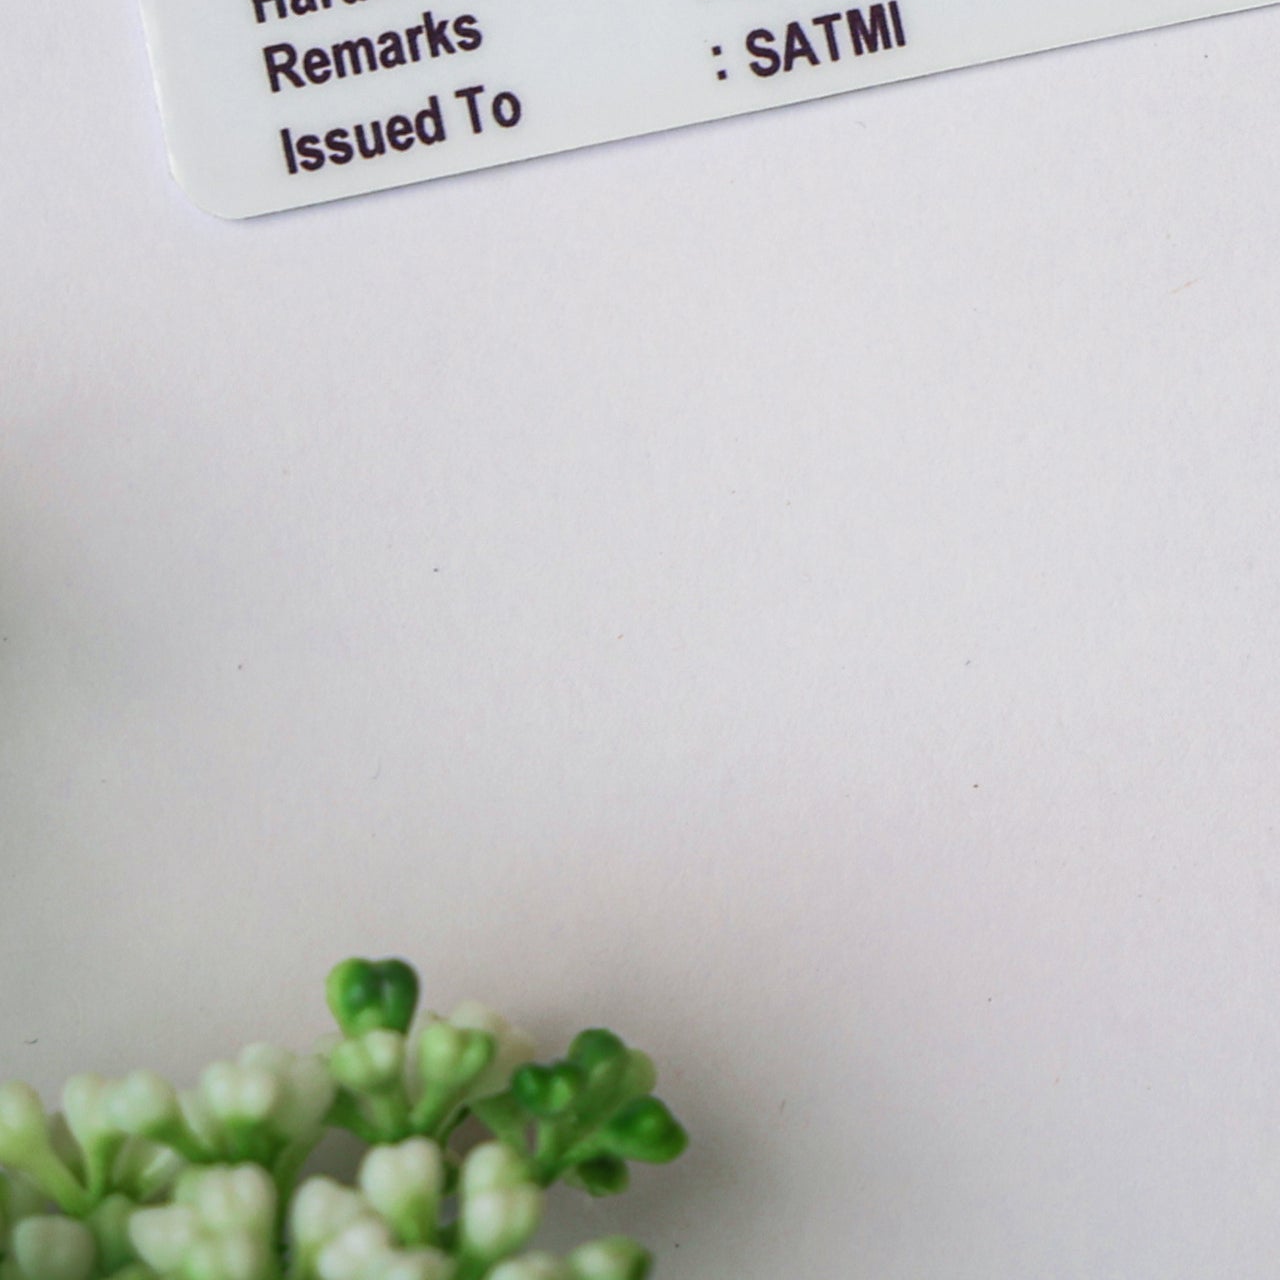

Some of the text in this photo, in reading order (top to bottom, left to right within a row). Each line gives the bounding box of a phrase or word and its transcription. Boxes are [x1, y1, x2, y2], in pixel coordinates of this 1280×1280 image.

[260, 10, 483, 94] Remarks
[279, 94, 446, 176] Issued
[454, 84, 522, 136] To
